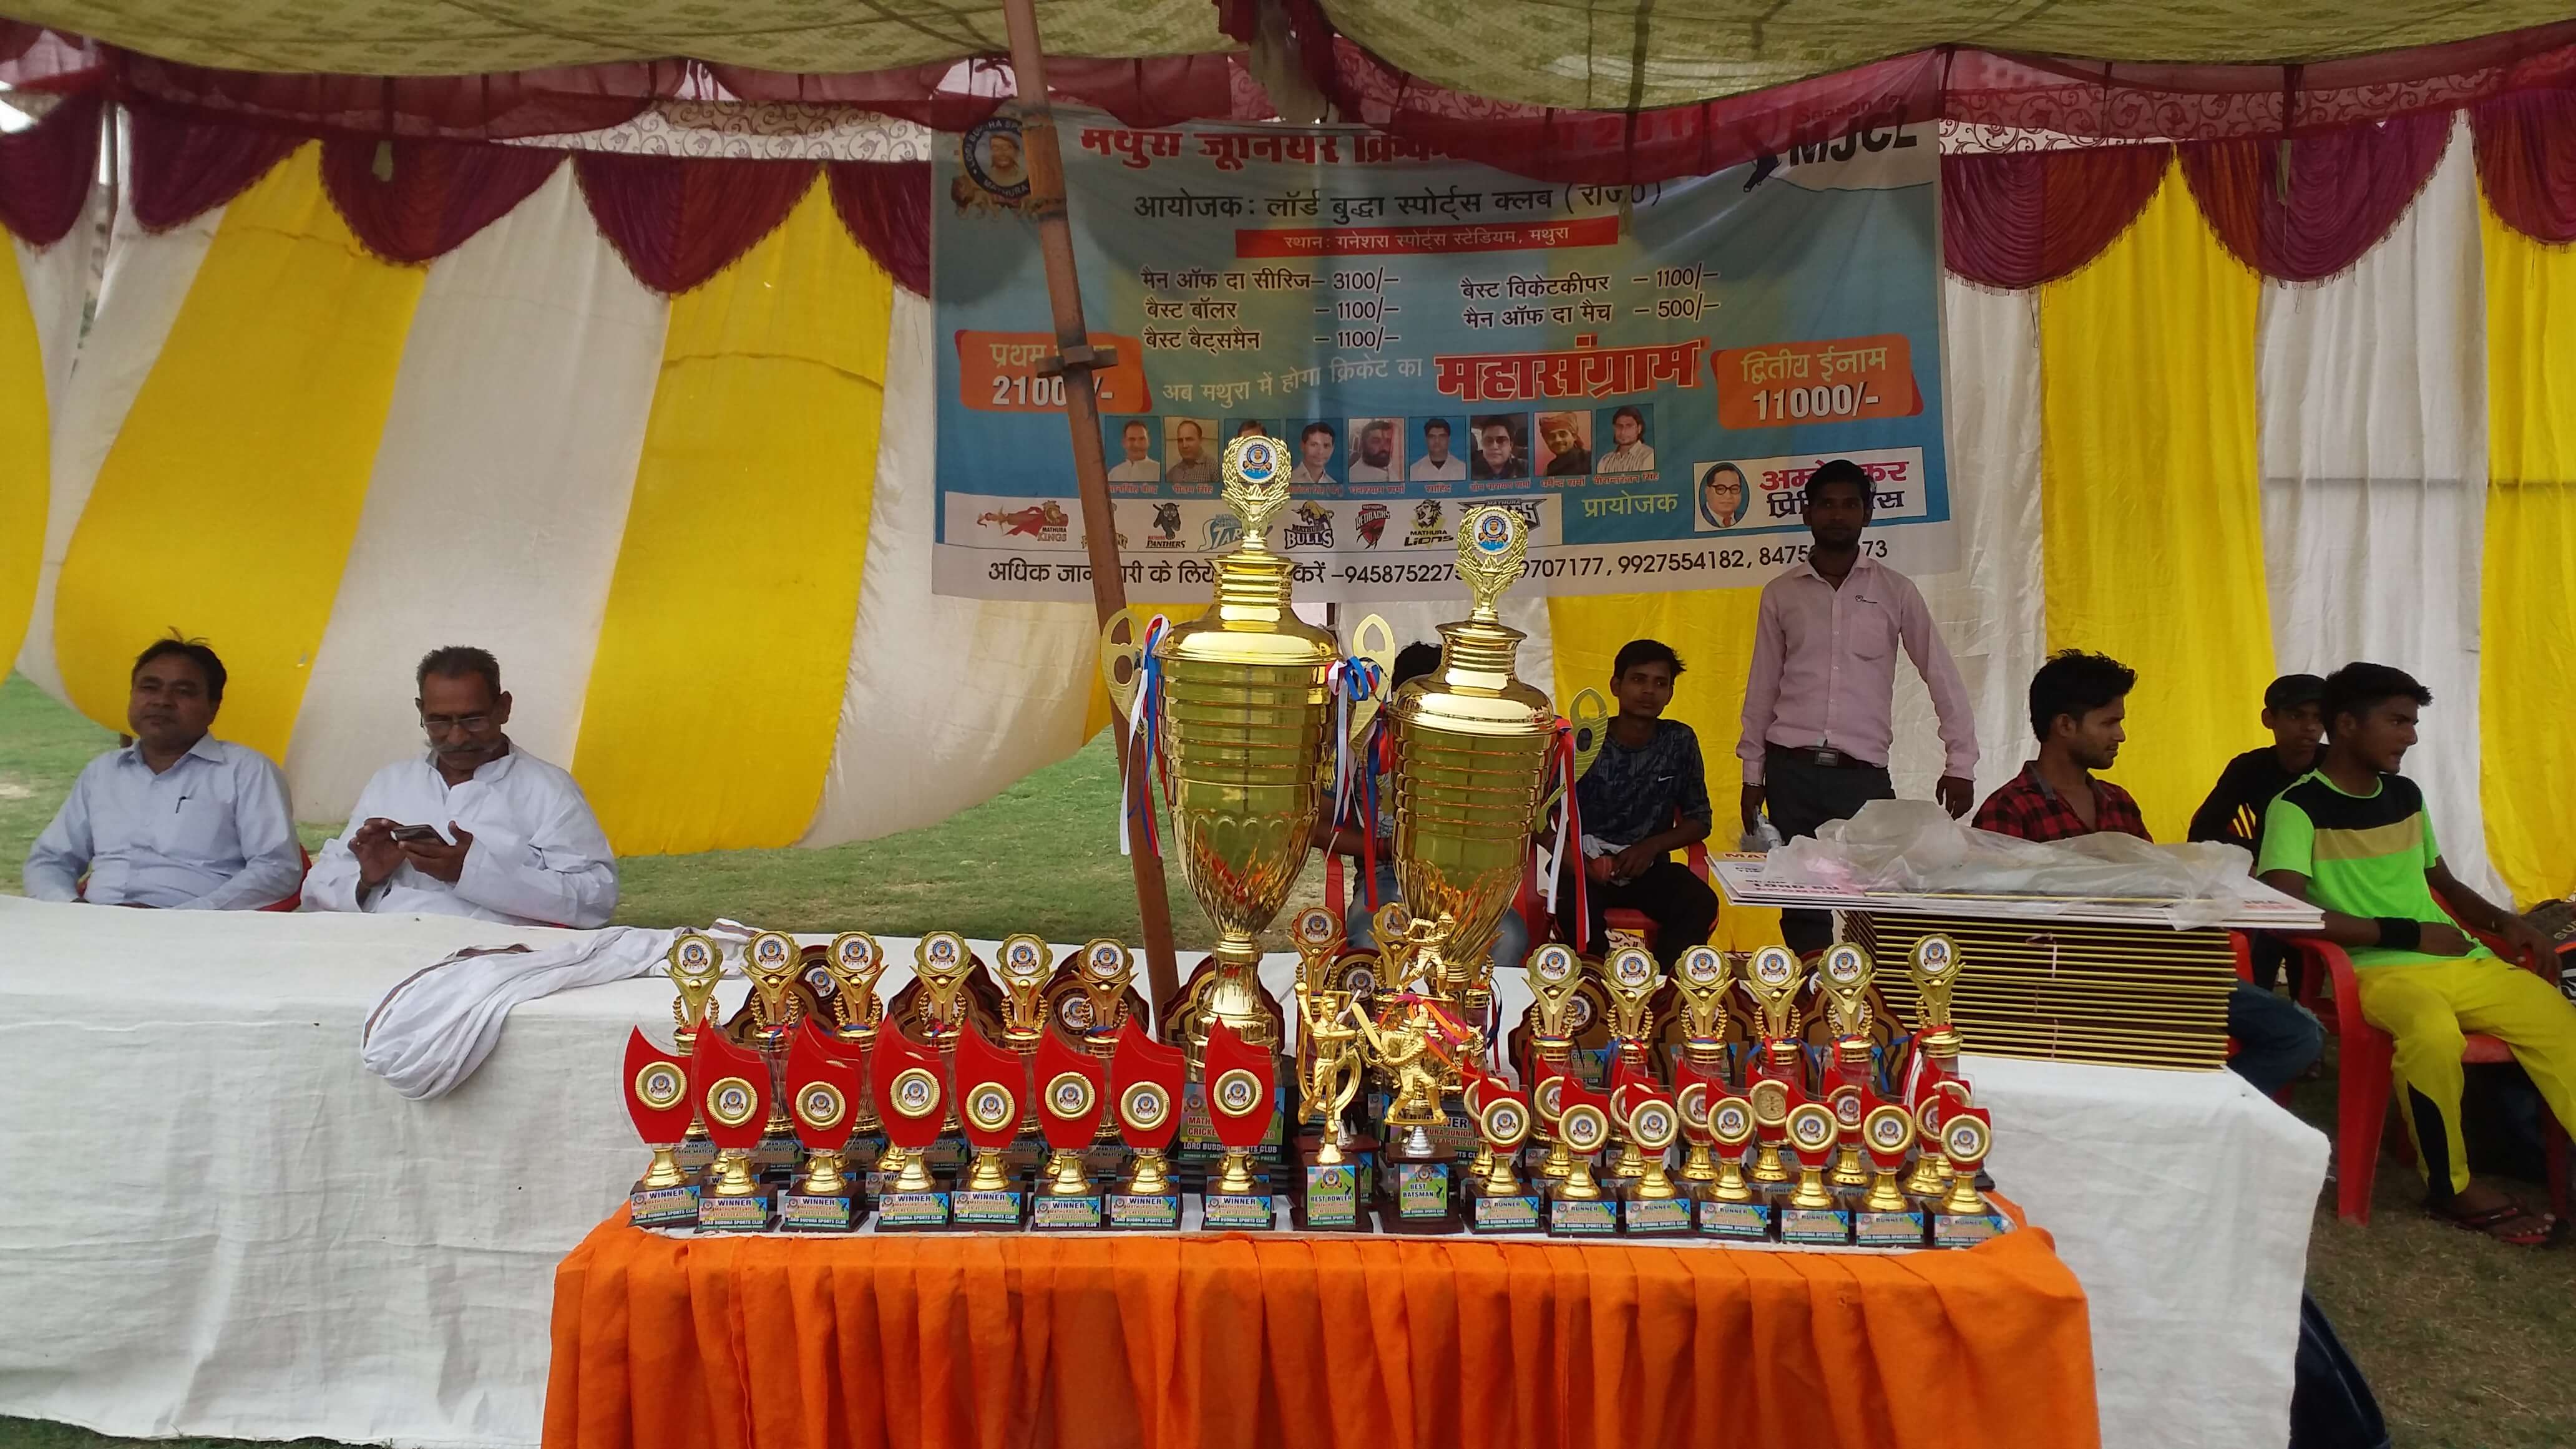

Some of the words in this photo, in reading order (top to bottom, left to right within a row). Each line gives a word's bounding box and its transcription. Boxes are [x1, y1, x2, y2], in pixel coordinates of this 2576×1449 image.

[1080, 128, 1183, 169] मथुरा
[1492, 190, 1553, 212] क्लब
[1528, 226, 1569, 245] मथुरा
[1177, 268, 1219, 290] ऑफ
[1224, 272, 1246, 290] दा
[1506, 272, 1611, 298] विकेटकीपर
[1189, 296, 1239, 321] बॉलर
[1501, 305, 1544, 326] ऑफ
[1550, 306, 1573, 324] दा
[1579, 298, 1612, 323] मैच
[1433, 334, 1704, 402] महासंग्राम
[1740, 348, 1810, 384] द्वितीय
[1817, 345, 1888, 383] ईनाम
[1163, 383, 1193, 401] अब
[1201, 381, 1250, 408] मथुरा
[1257, 371, 1275, 398] में
[1280, 366, 1322, 394] होगा
[1330, 356, 1389, 384] क्रिकेट
[1397, 358, 1423, 378] का
[1752, 381, 1880, 420] 11000/-
[1583, 490, 1679, 519] प्रायोजक
[1146, 540, 1187, 549] PANTHERS
[1284, 529, 1334, 550] BULLS
[988, 557, 1052, 583] अधिक
[1148, 560, 1172, 584] के
[1188, 1128, 1217, 1136] CRICKE
[1183, 1142, 1201, 1150] LORD
[649, 1189, 685, 1199] WINNER
[972, 1193, 1005, 1201] WINNER
